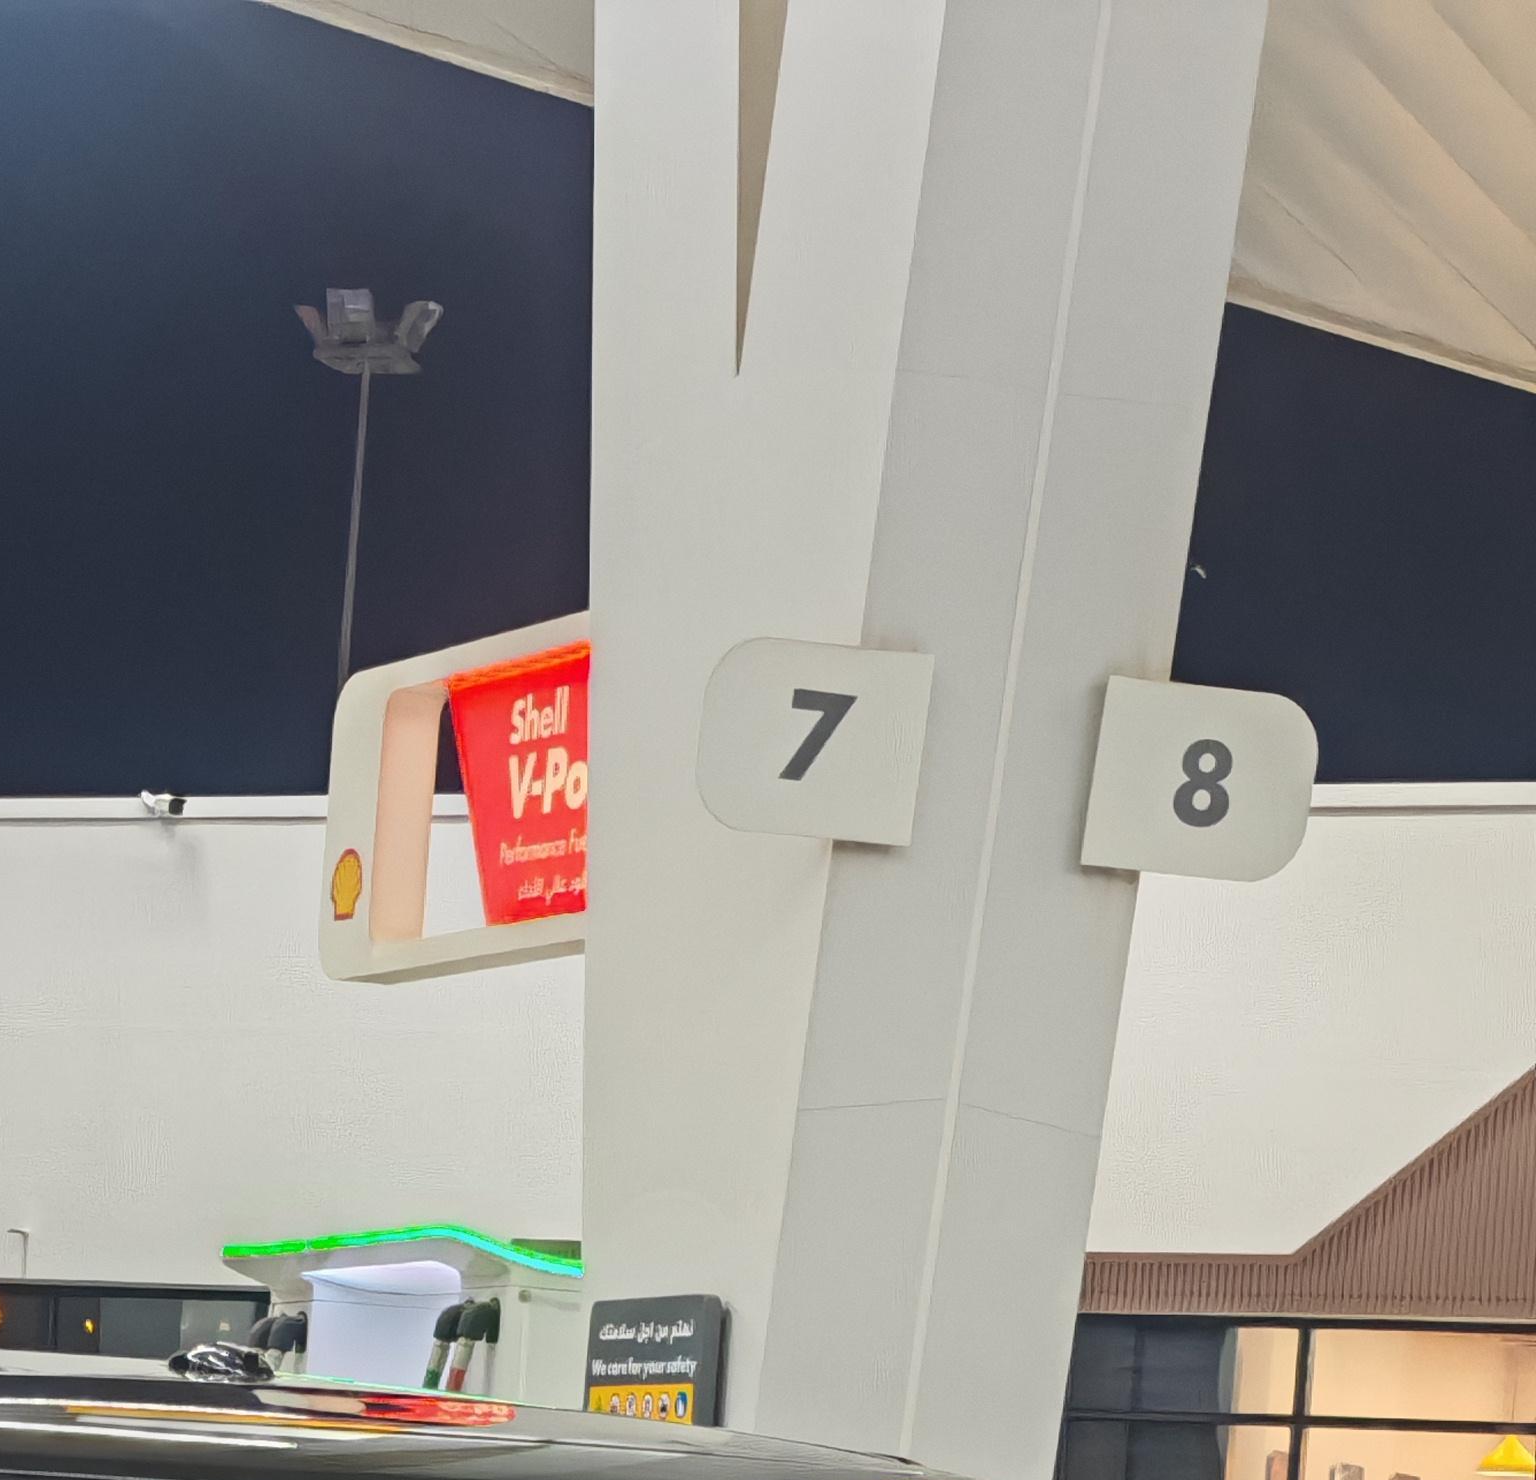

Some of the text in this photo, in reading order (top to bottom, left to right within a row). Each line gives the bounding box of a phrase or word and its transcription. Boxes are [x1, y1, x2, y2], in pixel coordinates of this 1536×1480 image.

[509, 685, 570, 744] Shell
[780, 689, 856, 780] 7
[1174, 740, 1232, 827] 8
[655, 1323, 668, 1343] من
[592, 1355, 697, 1380] We care for your safety
